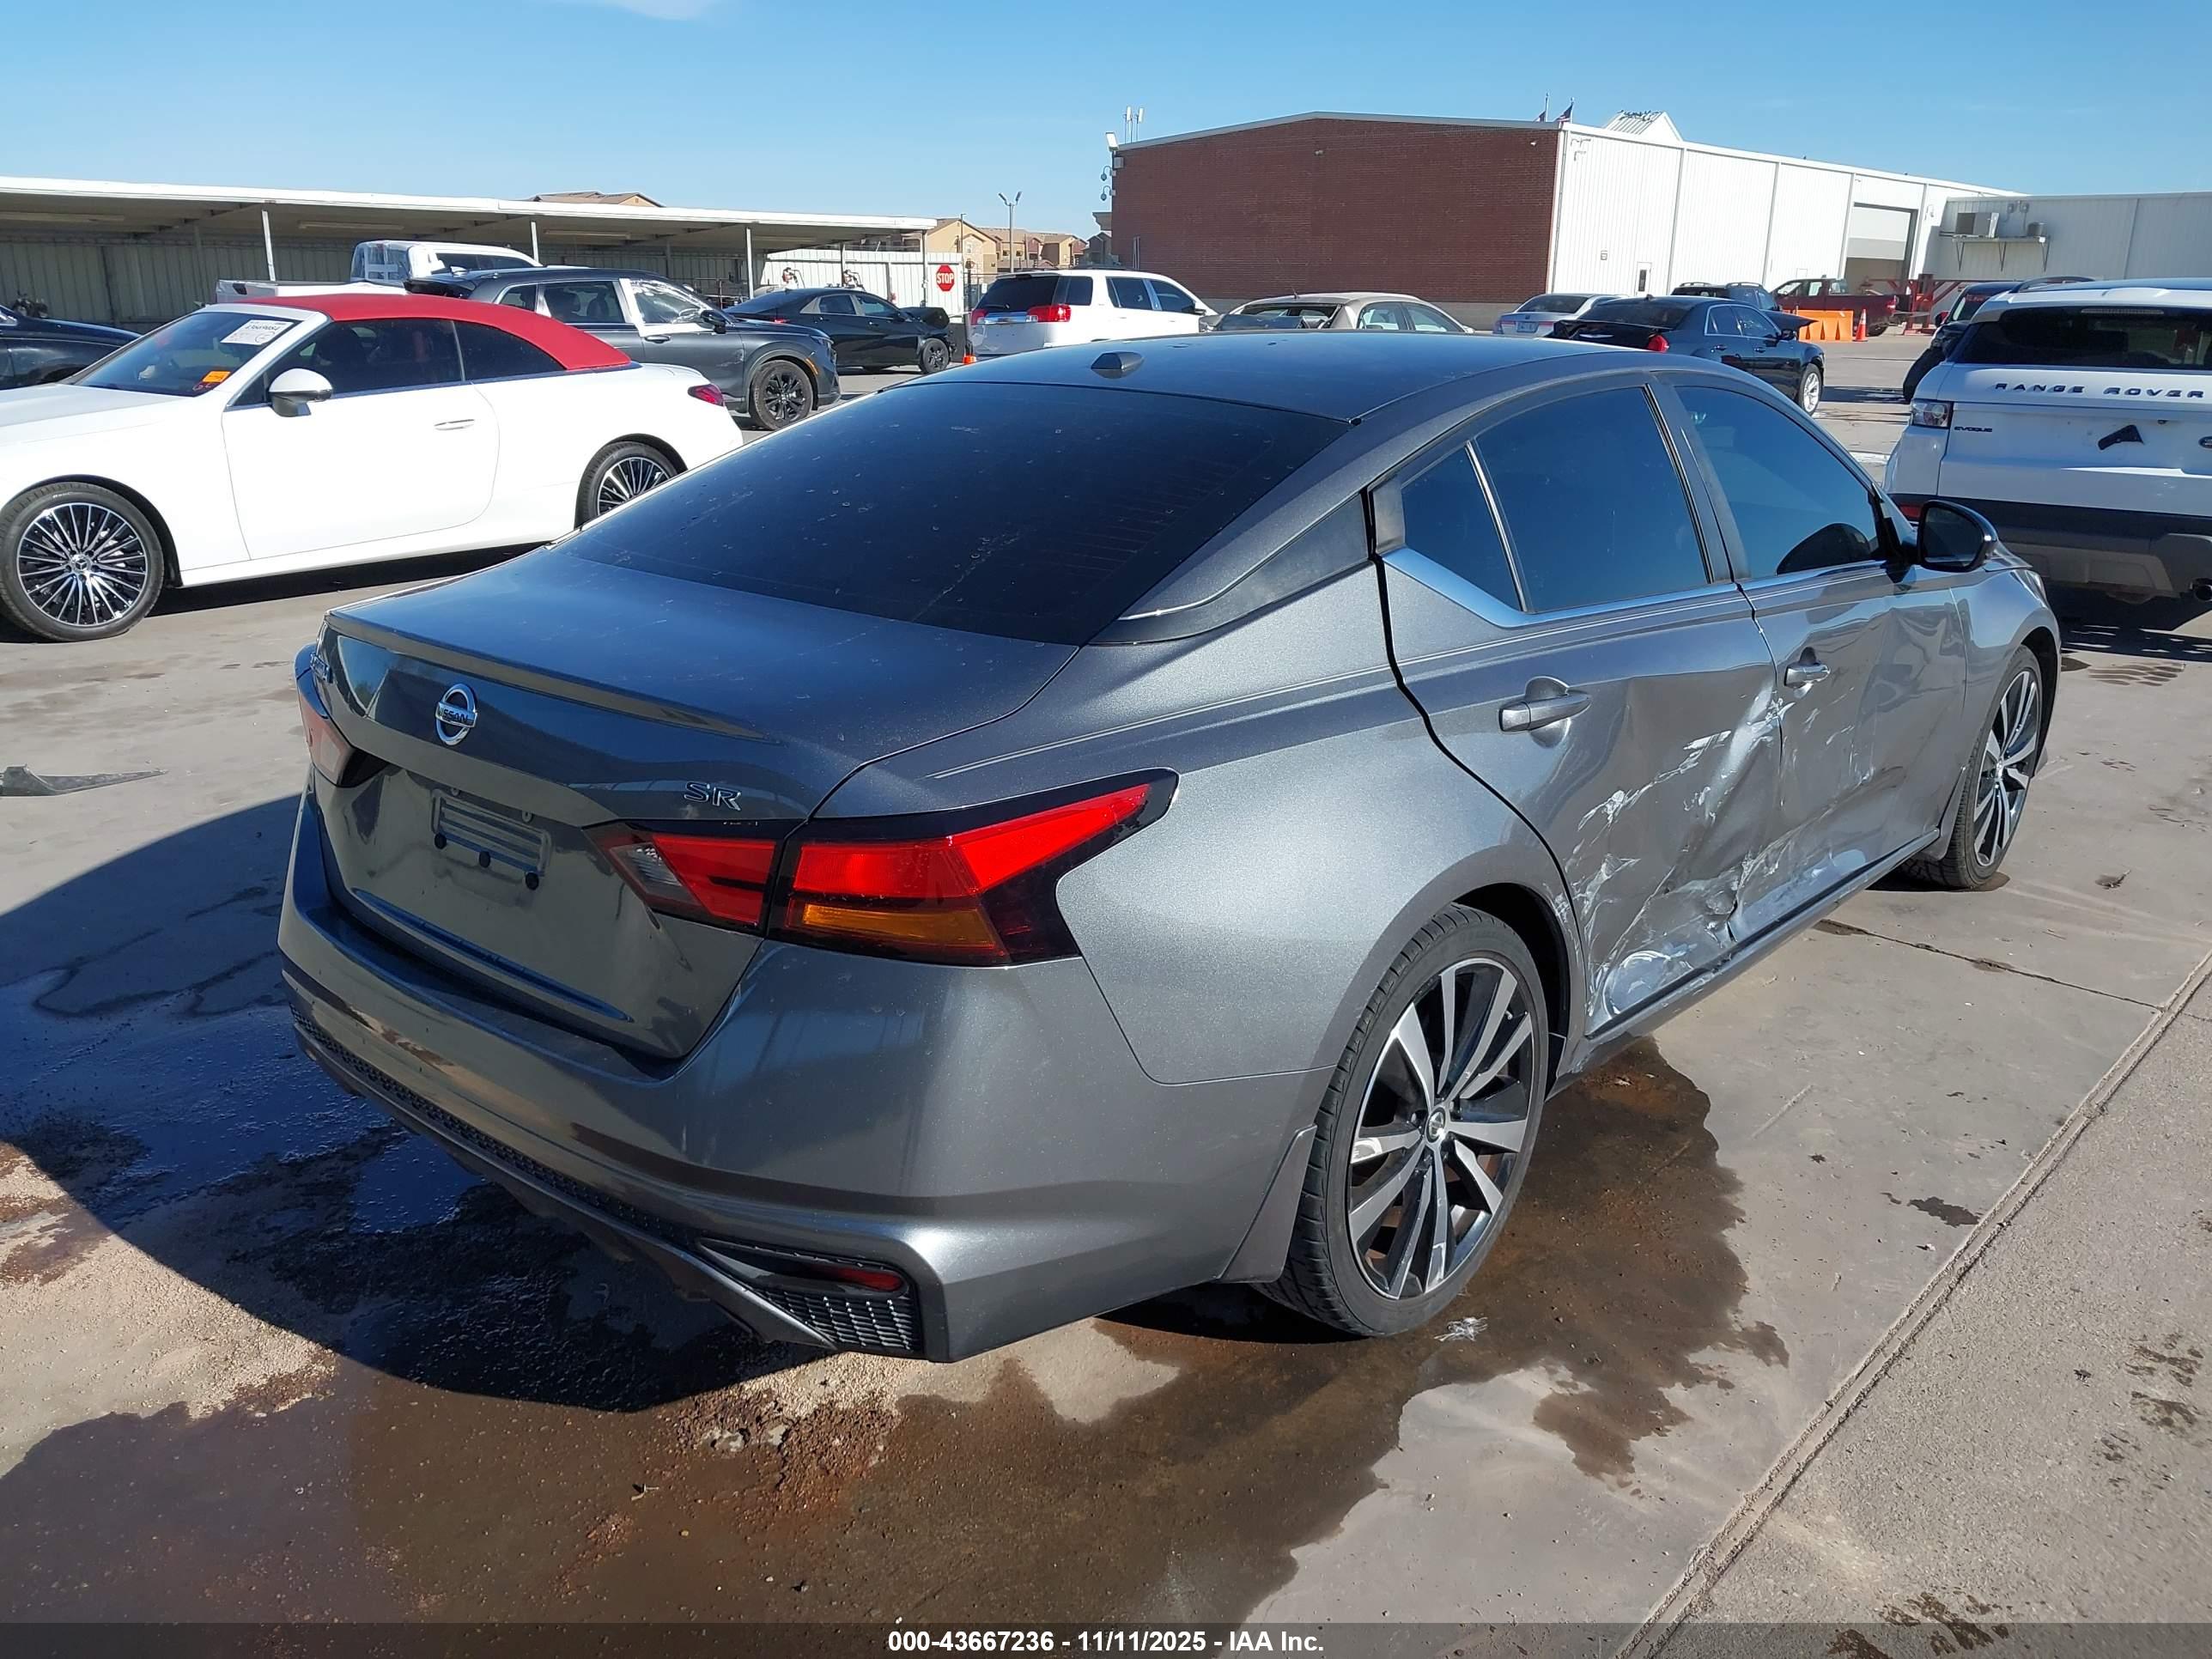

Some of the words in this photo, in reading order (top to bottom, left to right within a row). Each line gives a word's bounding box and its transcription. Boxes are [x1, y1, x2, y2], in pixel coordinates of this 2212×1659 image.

[937, 272, 954, 284] STOP
[1995, 383, 2085, 393] RANGE
[2103, 387, 2204, 398] ROVER
[684, 781, 742, 811] SR
